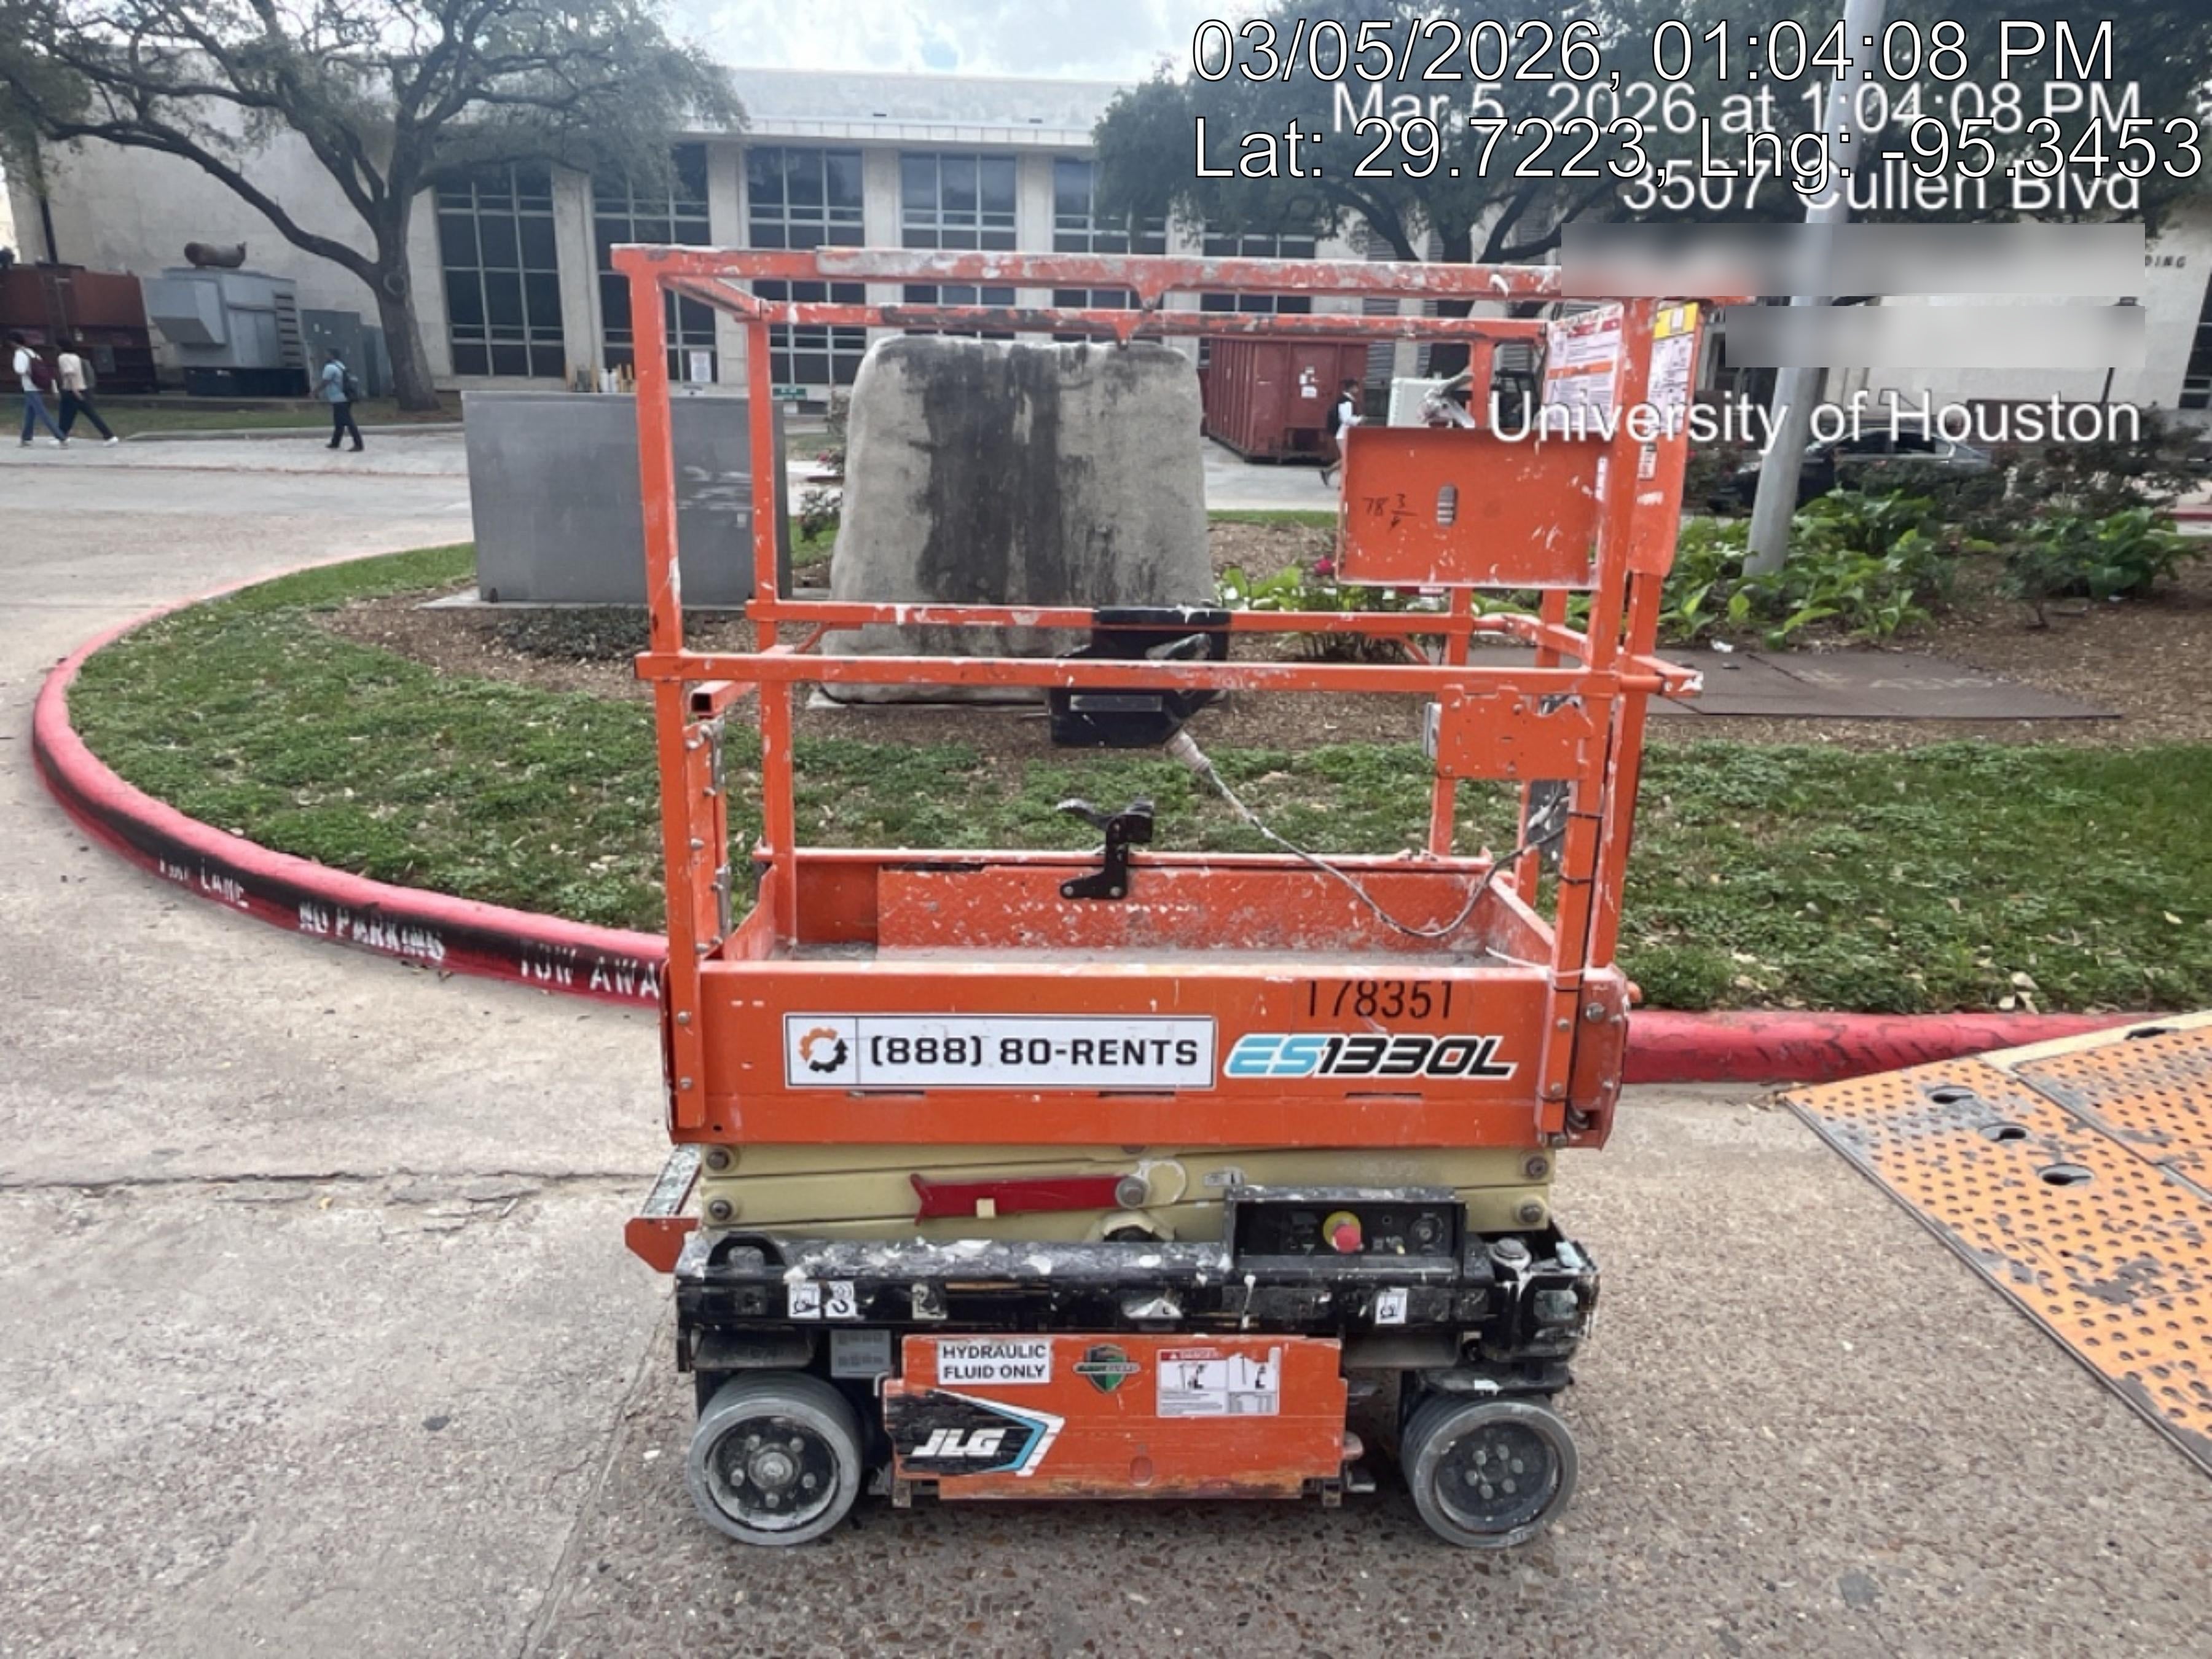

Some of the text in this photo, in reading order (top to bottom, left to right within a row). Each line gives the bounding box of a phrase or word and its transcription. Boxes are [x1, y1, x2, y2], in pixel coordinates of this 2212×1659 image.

[1306, 980, 1454, 1018] 178351
[871, 1035, 1198, 1067] (888) 80-RENTS
[1228, 1035, 1515, 1077] ES1330L
[942, 1344, 1046, 1360] HYDRAULIC
[943, 1363, 1045, 1380] FLUID ONLY
[911, 1429, 1008, 1457] JLG
